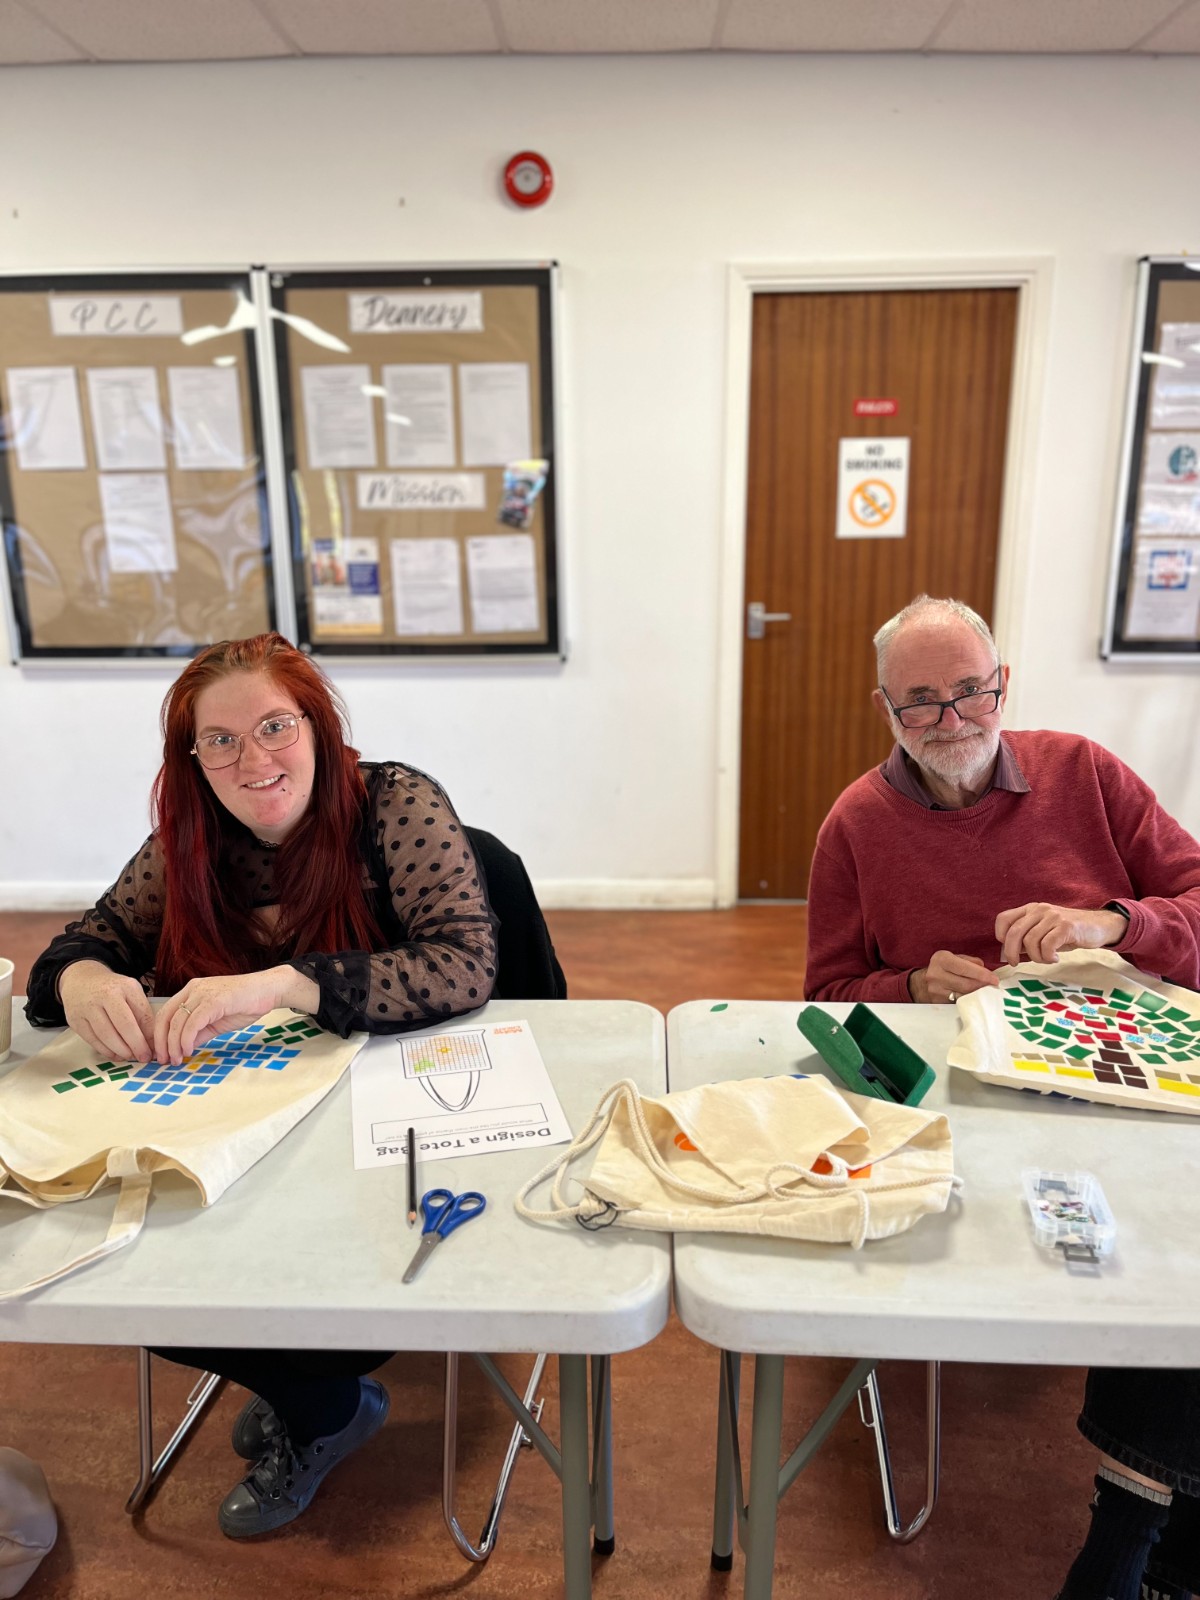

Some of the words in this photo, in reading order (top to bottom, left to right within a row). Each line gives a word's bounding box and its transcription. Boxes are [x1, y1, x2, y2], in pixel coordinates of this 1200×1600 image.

[864, 444, 885, 457] NO
[845, 458, 903, 472] SMOKING
[366, 475, 467, 506] Mission
[468, 1137, 481, 1145] a
[486, 1127, 552, 1143] Design
[419, 1139, 466, 1151] Tote
